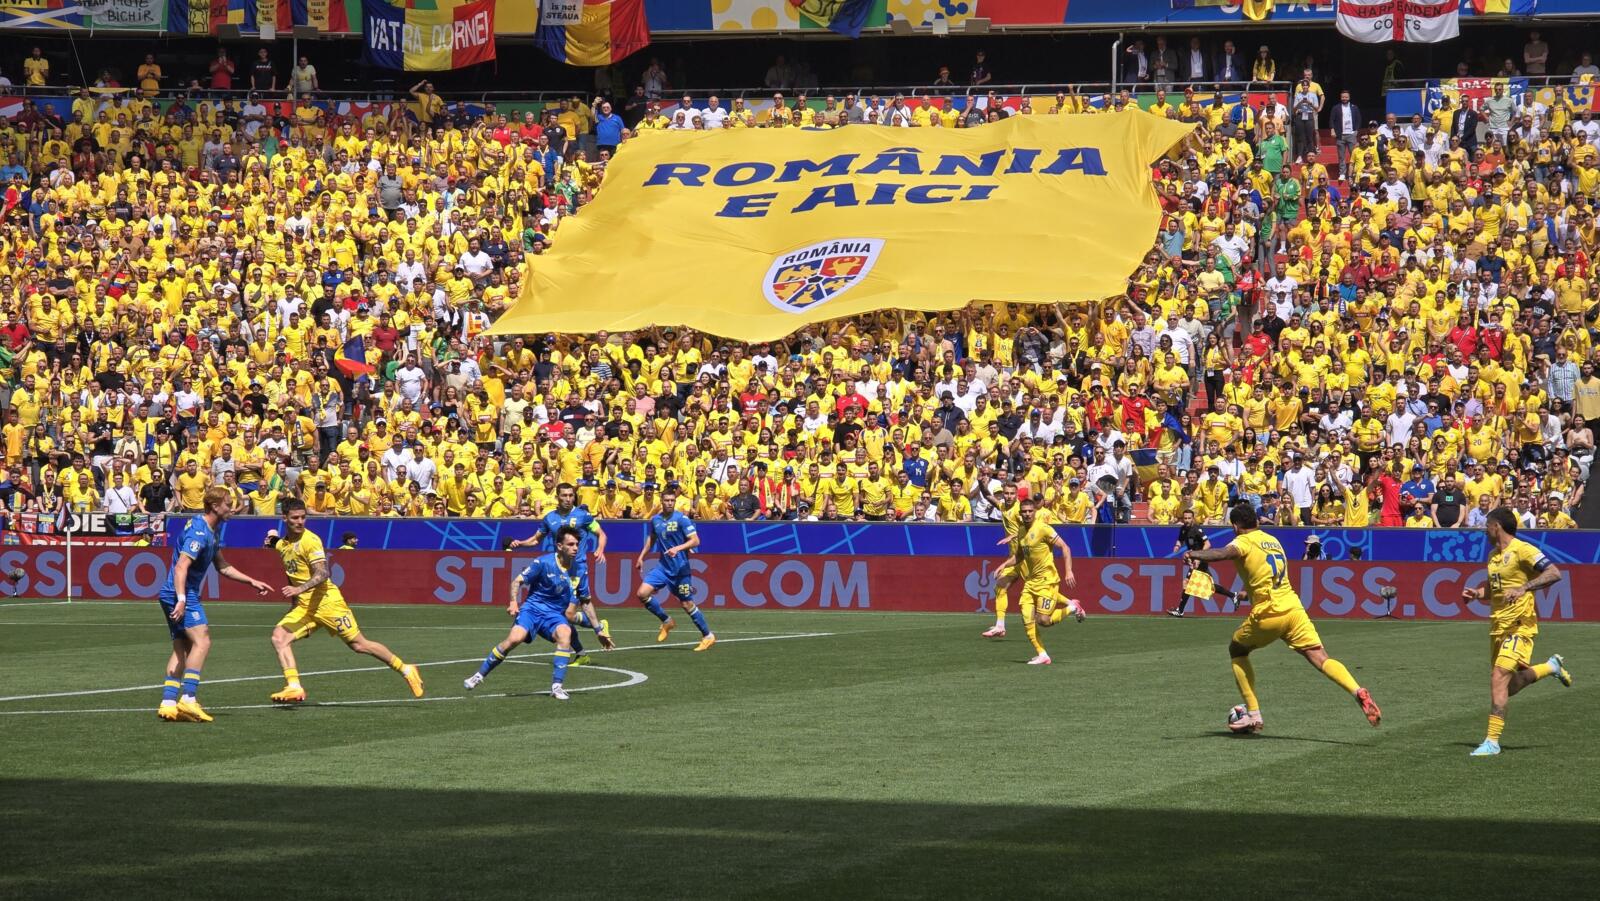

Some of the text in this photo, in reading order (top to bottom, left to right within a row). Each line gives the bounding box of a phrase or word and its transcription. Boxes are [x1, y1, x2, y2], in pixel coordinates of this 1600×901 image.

[545, 12, 580, 20] STEAUA
[1356, 3, 1442, 17] HARPENDEN
[370, 10, 489, 54] VATRA DORNEI
[1374, 18, 1421, 31] COLTS
[642, 147, 1108, 187] ROMÂNIA
[714, 183, 1000, 218] E AICI
[783, 241, 871, 265] ROMÂNIA
[64, 513, 107, 532] DIE
[666, 521, 678, 532] 22
[433, 555, 871, 608] STUS.COM
[1266, 554, 1286, 590] 17
[1099, 563, 1575, 619] STSS.CM
[1042, 597, 1051, 610] 18
[334, 616, 352, 634] 20
[1502, 633, 1520, 652] 21
